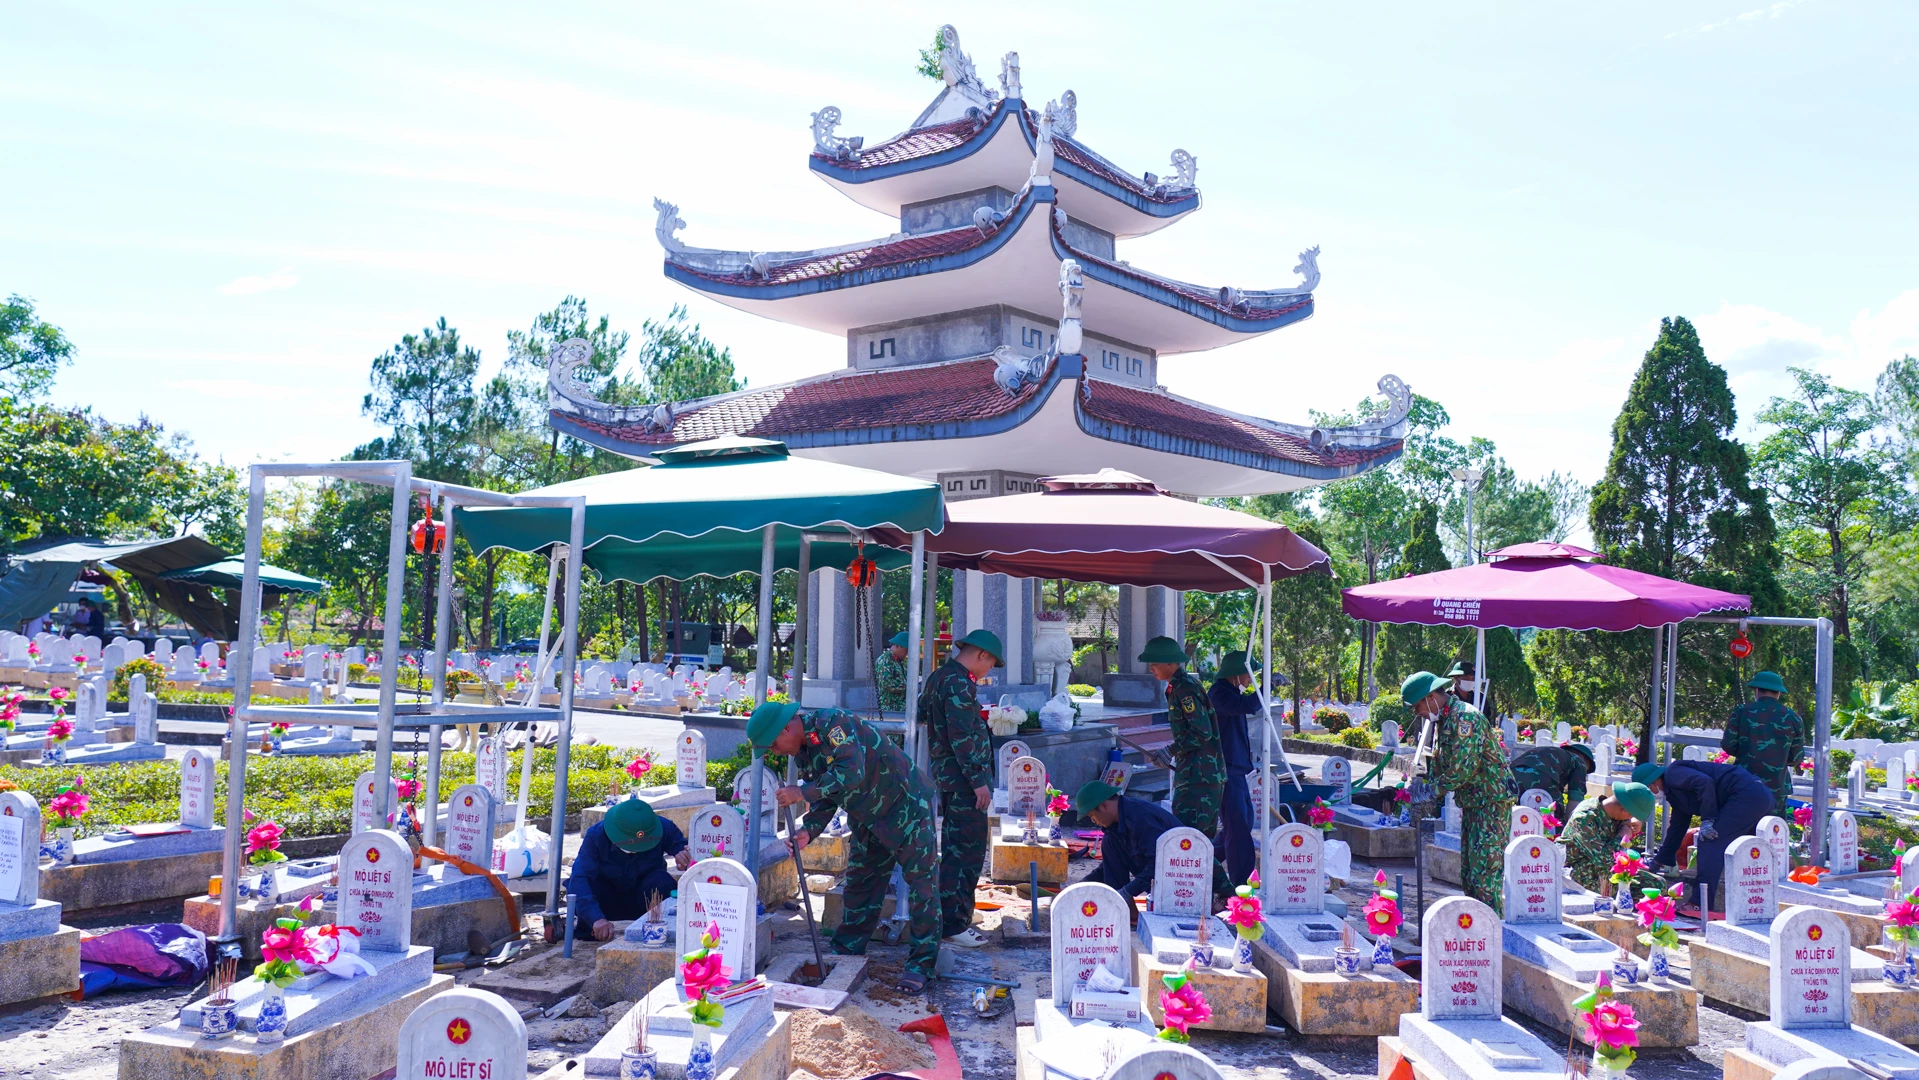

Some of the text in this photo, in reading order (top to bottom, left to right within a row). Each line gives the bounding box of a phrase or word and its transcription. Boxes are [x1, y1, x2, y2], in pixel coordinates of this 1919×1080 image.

[1071, 924, 1114, 941] MỘ LIỆT SĨ
[1081, 945, 1091, 954] XÁC
[1444, 938, 1486, 954] MỘ LIỆT SĨ
[1796, 947, 1835, 963] MỘ LIỆT SĨ
[1079, 956, 1096, 965] THÔNG
[1453, 958, 1464, 966] XÁC
[1452, 969, 1468, 978] THÔNG
[1803, 977, 1819, 985] THÔNG
[479, 1058, 492, 1080] SĨ
